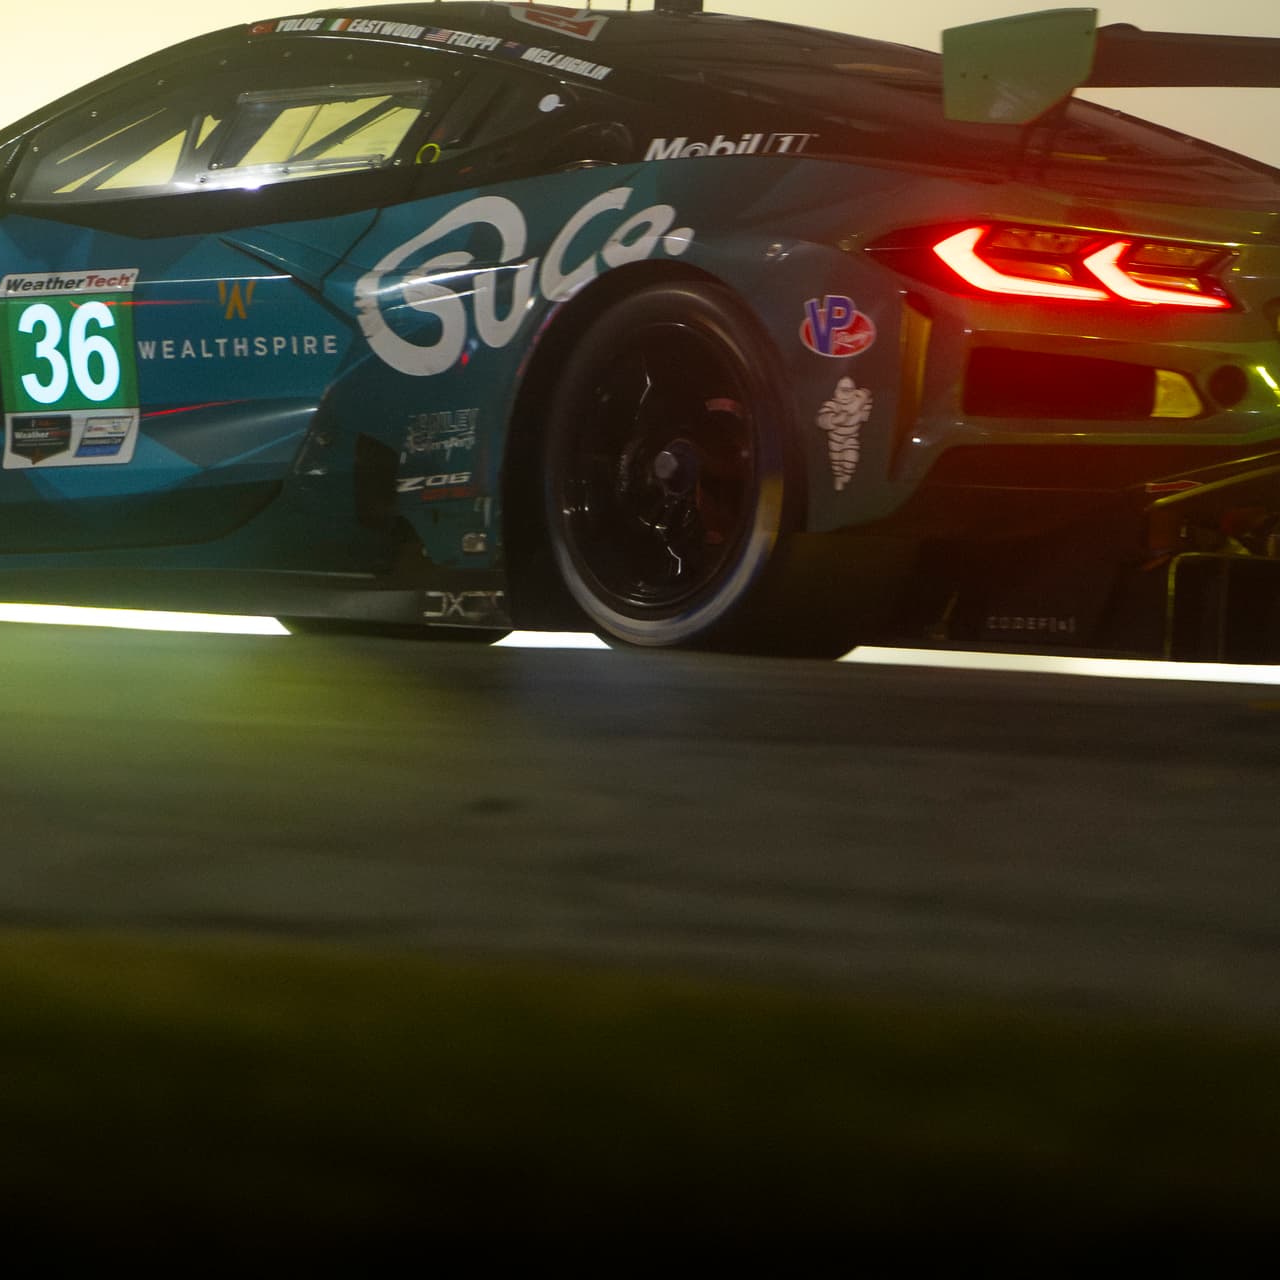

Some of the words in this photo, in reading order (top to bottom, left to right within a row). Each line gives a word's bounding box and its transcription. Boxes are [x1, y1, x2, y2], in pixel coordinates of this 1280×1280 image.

[347, 19, 425, 39] EASTWOOD
[447, 32, 503, 51] FILIPPI
[643, 133, 764, 162] Mobil
[6, 273, 132, 292] WeatherTech
[805, 295, 855, 354] VP
[18, 301, 120, 404] 36
[137, 335, 338, 359] WEALTHSPIRE
[396, 472, 472, 493] Z06
